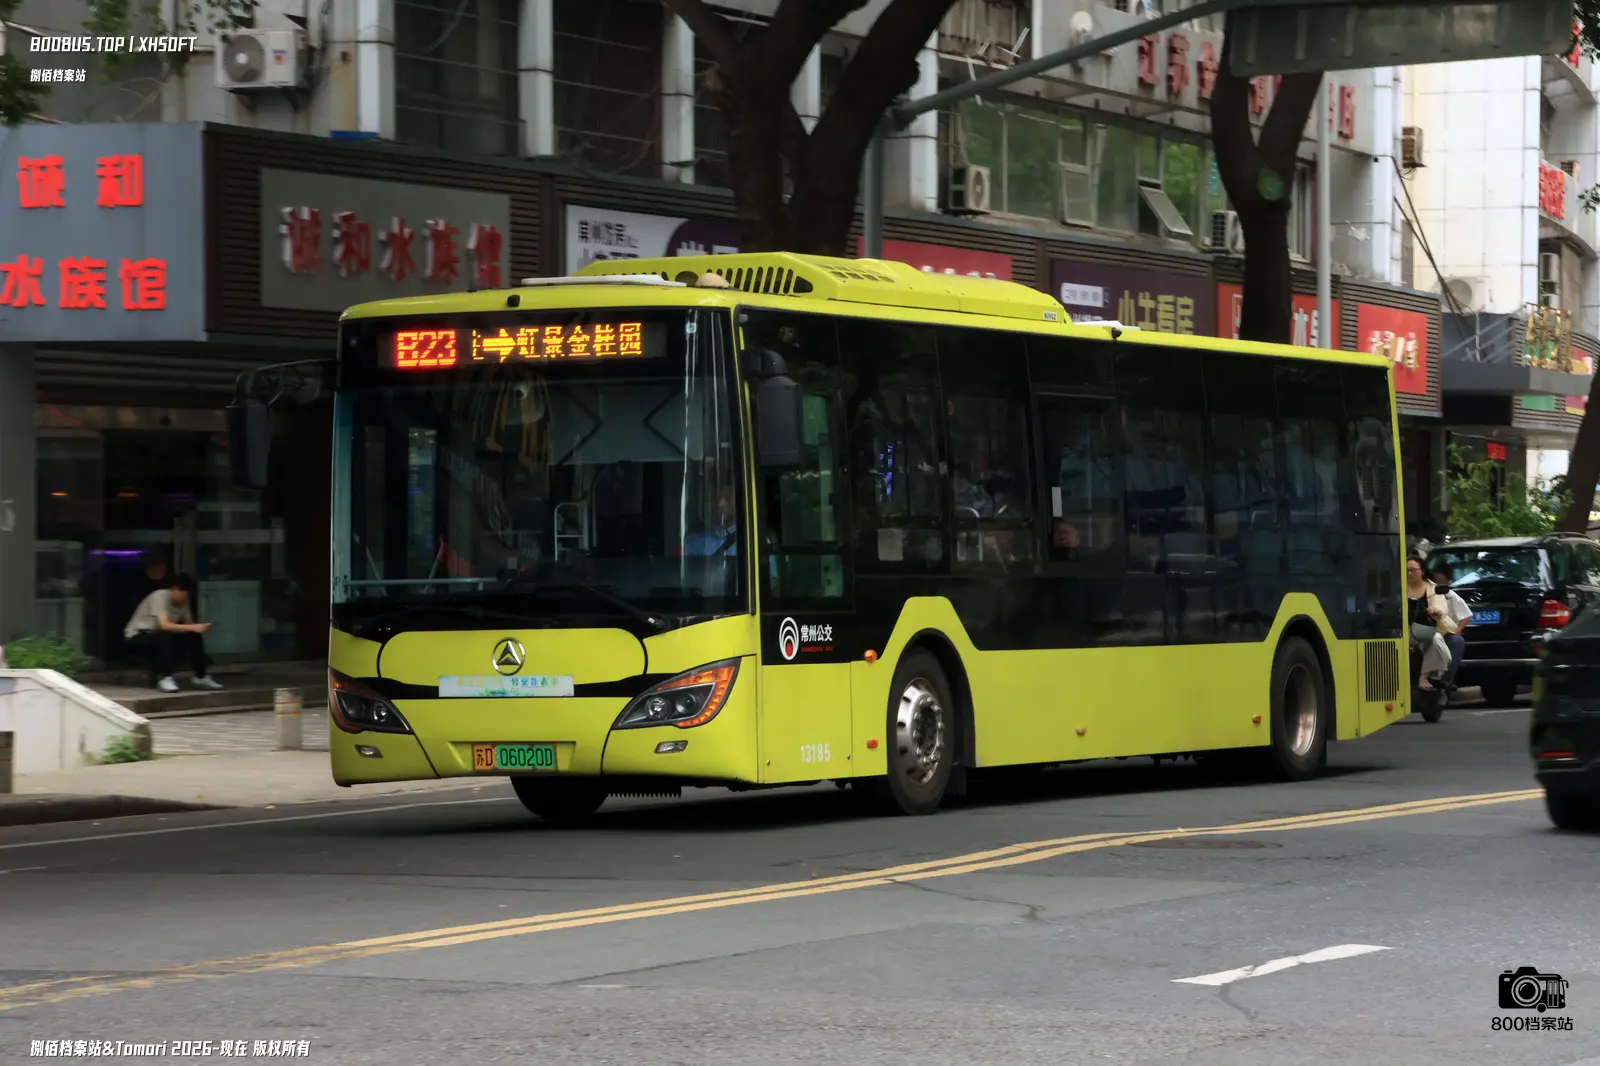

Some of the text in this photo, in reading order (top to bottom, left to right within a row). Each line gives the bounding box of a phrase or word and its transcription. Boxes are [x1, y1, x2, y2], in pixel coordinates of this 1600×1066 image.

[16, 154, 143, 208] 诚和
[279, 206, 503, 288] 诚和水族馆
[0, 254, 167, 310] 水族馆
[397, 330, 456, 367] B23
[800, 624, 833, 642] 常州公交
[800, 743, 831, 762] 13185
